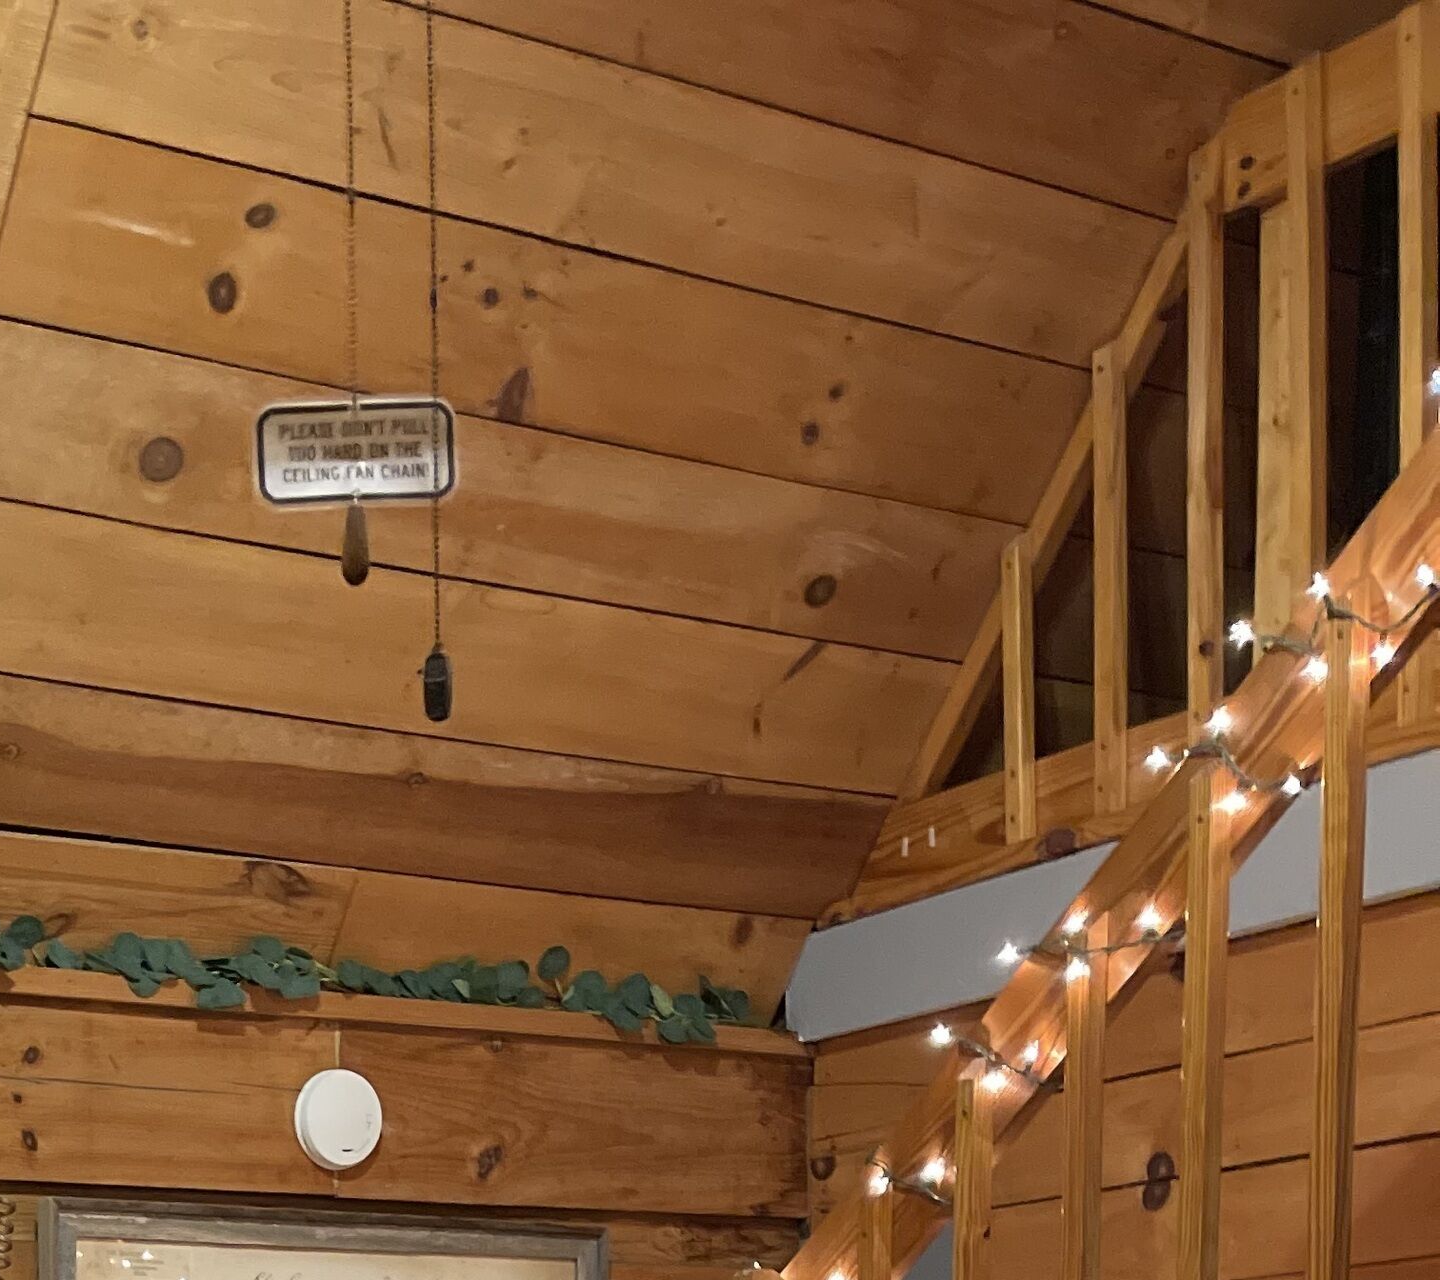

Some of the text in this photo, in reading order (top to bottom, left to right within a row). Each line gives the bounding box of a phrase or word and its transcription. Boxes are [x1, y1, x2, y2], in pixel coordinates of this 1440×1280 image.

[278, 422, 334, 440] PLEASE
[288, 441, 422, 462] TOO HARD ON THE
[283, 466, 340, 483] CEILING
[346, 464, 374, 479] FAN
